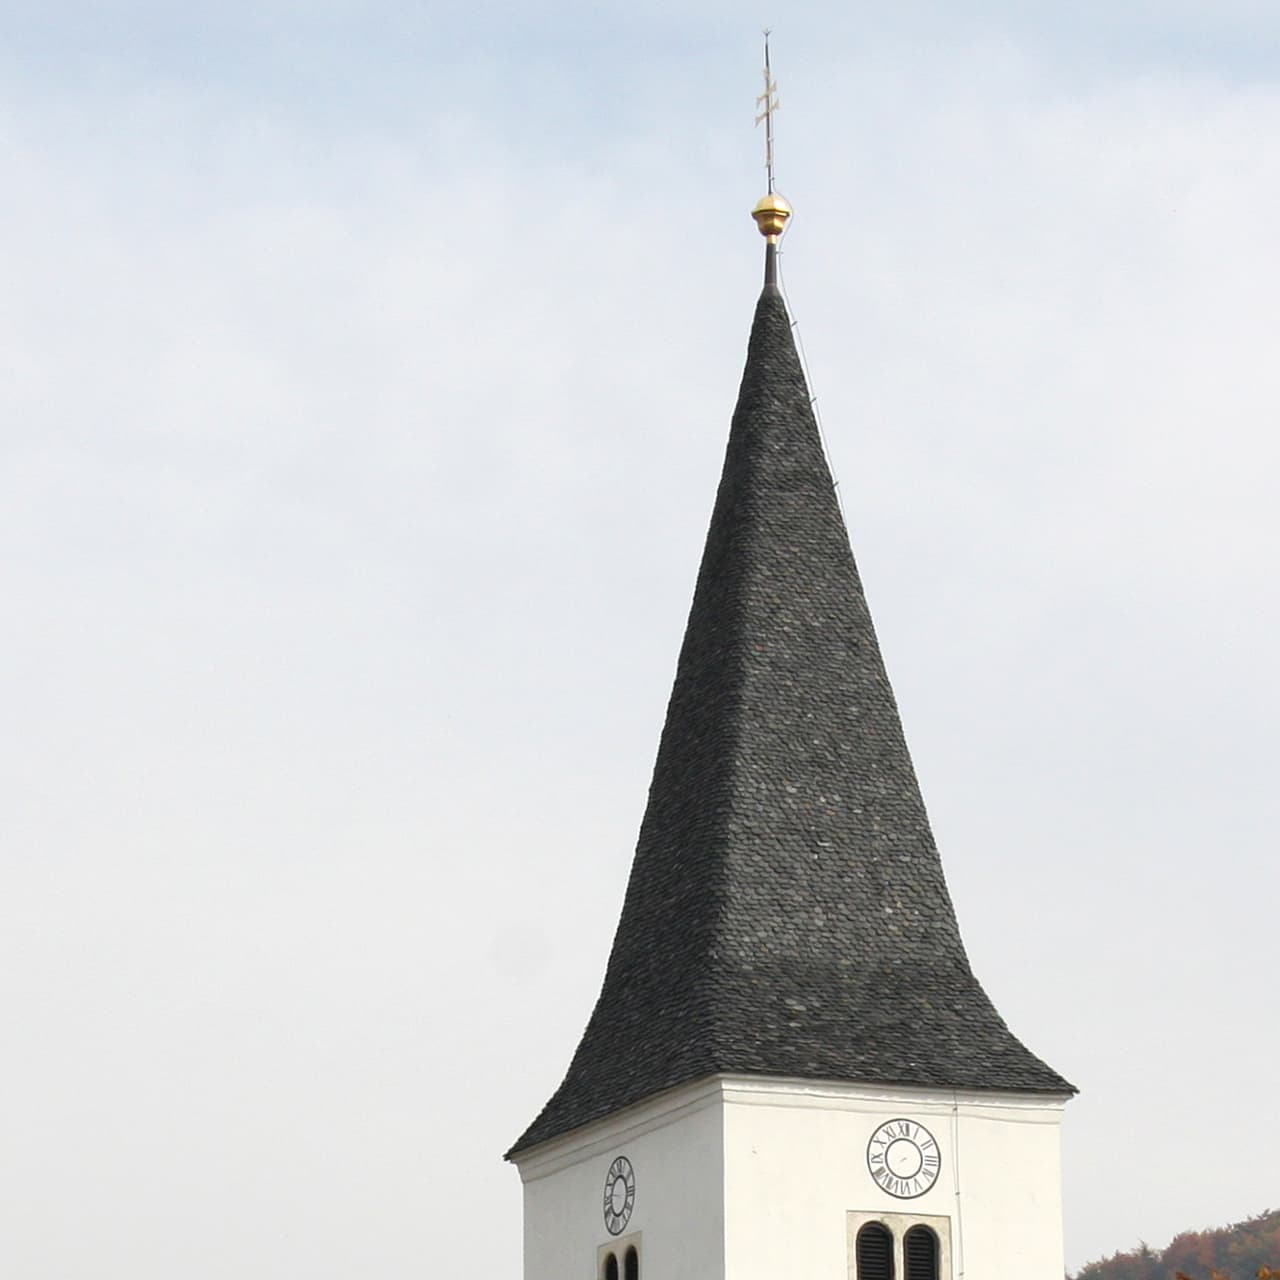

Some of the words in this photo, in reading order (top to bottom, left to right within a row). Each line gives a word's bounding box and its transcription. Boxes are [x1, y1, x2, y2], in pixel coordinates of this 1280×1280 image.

[913, 1127, 919, 1139] I
[873, 1137, 887, 1149] X
[921, 1139, 933, 1151] II
[925, 1155, 937, 1166] III
[914, 1178, 923, 1192] V
